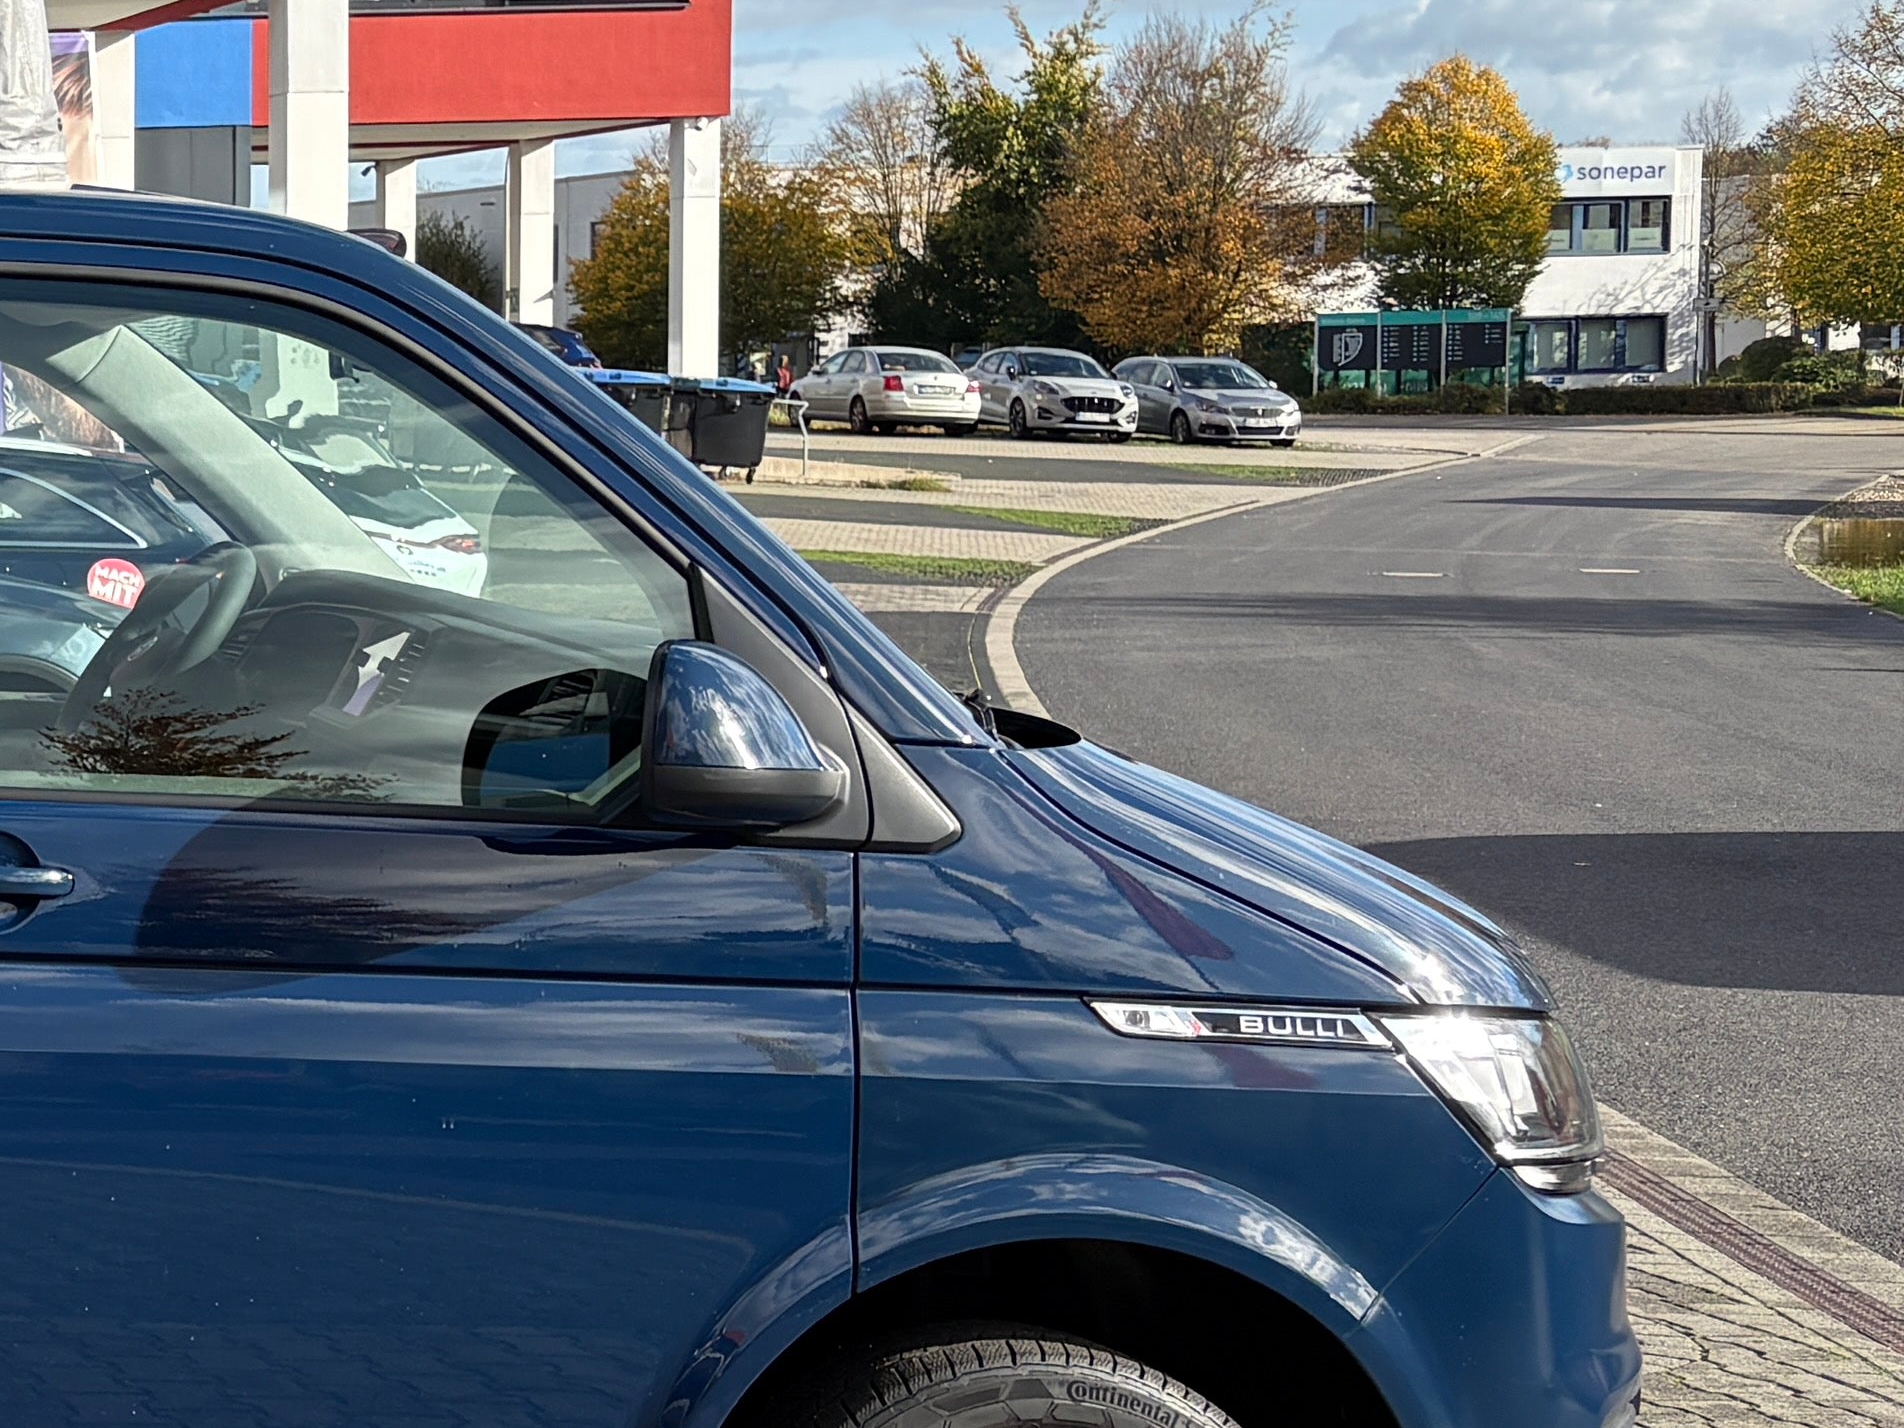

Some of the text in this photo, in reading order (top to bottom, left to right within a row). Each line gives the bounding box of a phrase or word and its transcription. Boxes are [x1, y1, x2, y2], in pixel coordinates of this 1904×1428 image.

[1577, 165, 1666, 182] sonepar
[95, 565, 141, 587] MACH
[92, 577, 138, 605] MIT
[1239, 1015, 1344, 1037] BULLI
